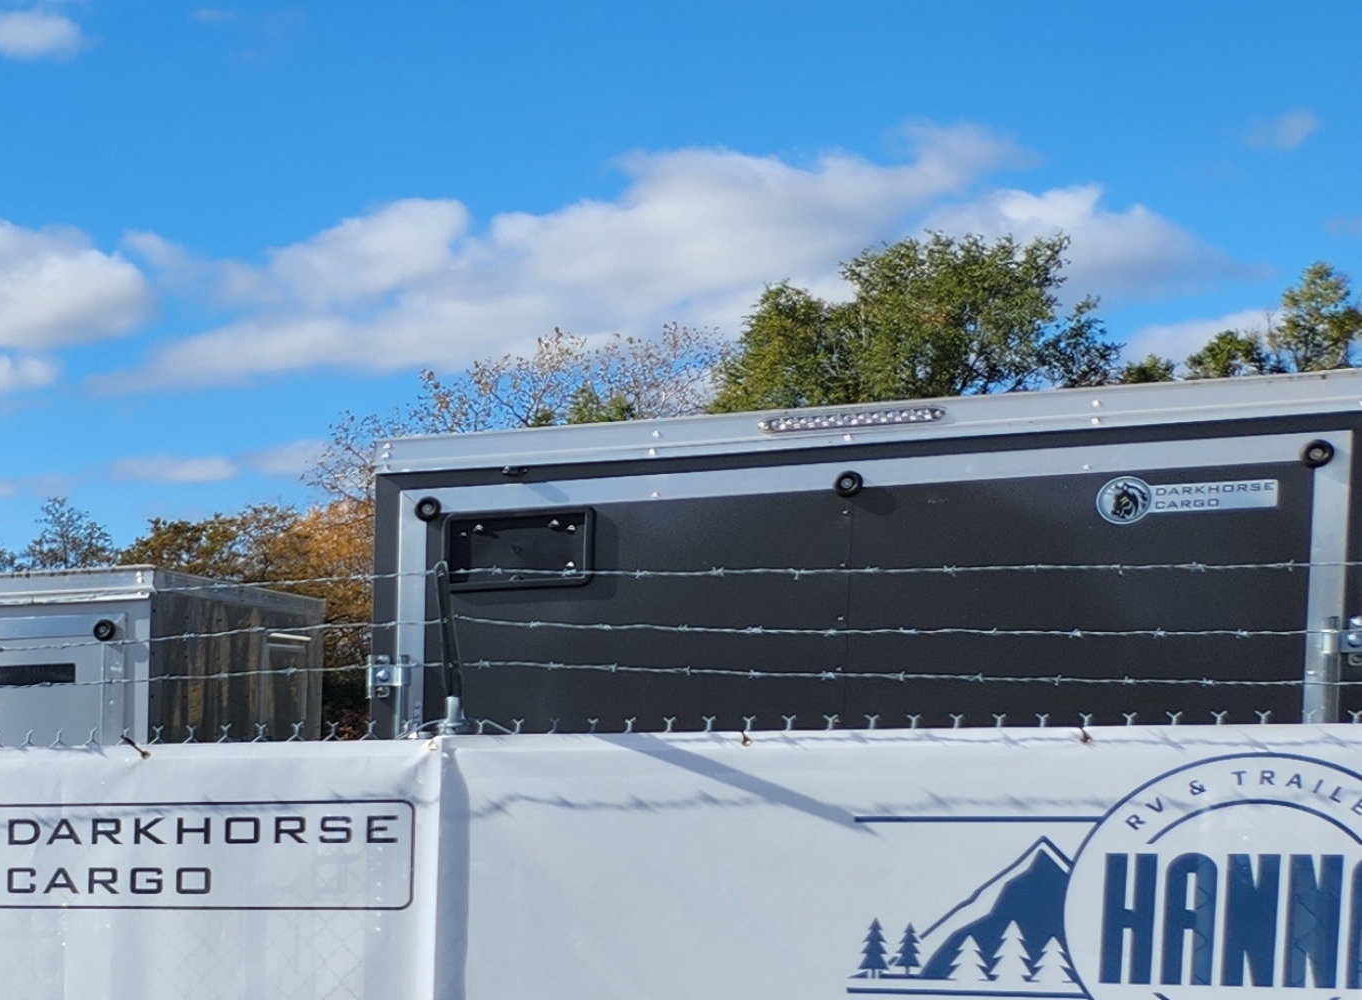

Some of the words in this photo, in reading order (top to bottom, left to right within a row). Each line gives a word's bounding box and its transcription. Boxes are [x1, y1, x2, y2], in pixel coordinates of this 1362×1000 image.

[1155, 482, 1275, 496] DARKHORSE
[1154, 498, 1220, 510] CARGO
[1125, 797, 1165, 831] RV
[1188, 779, 1207, 797] &
[7, 814, 400, 845] DARKHORSE
[7, 866, 212, 895] CARGO
